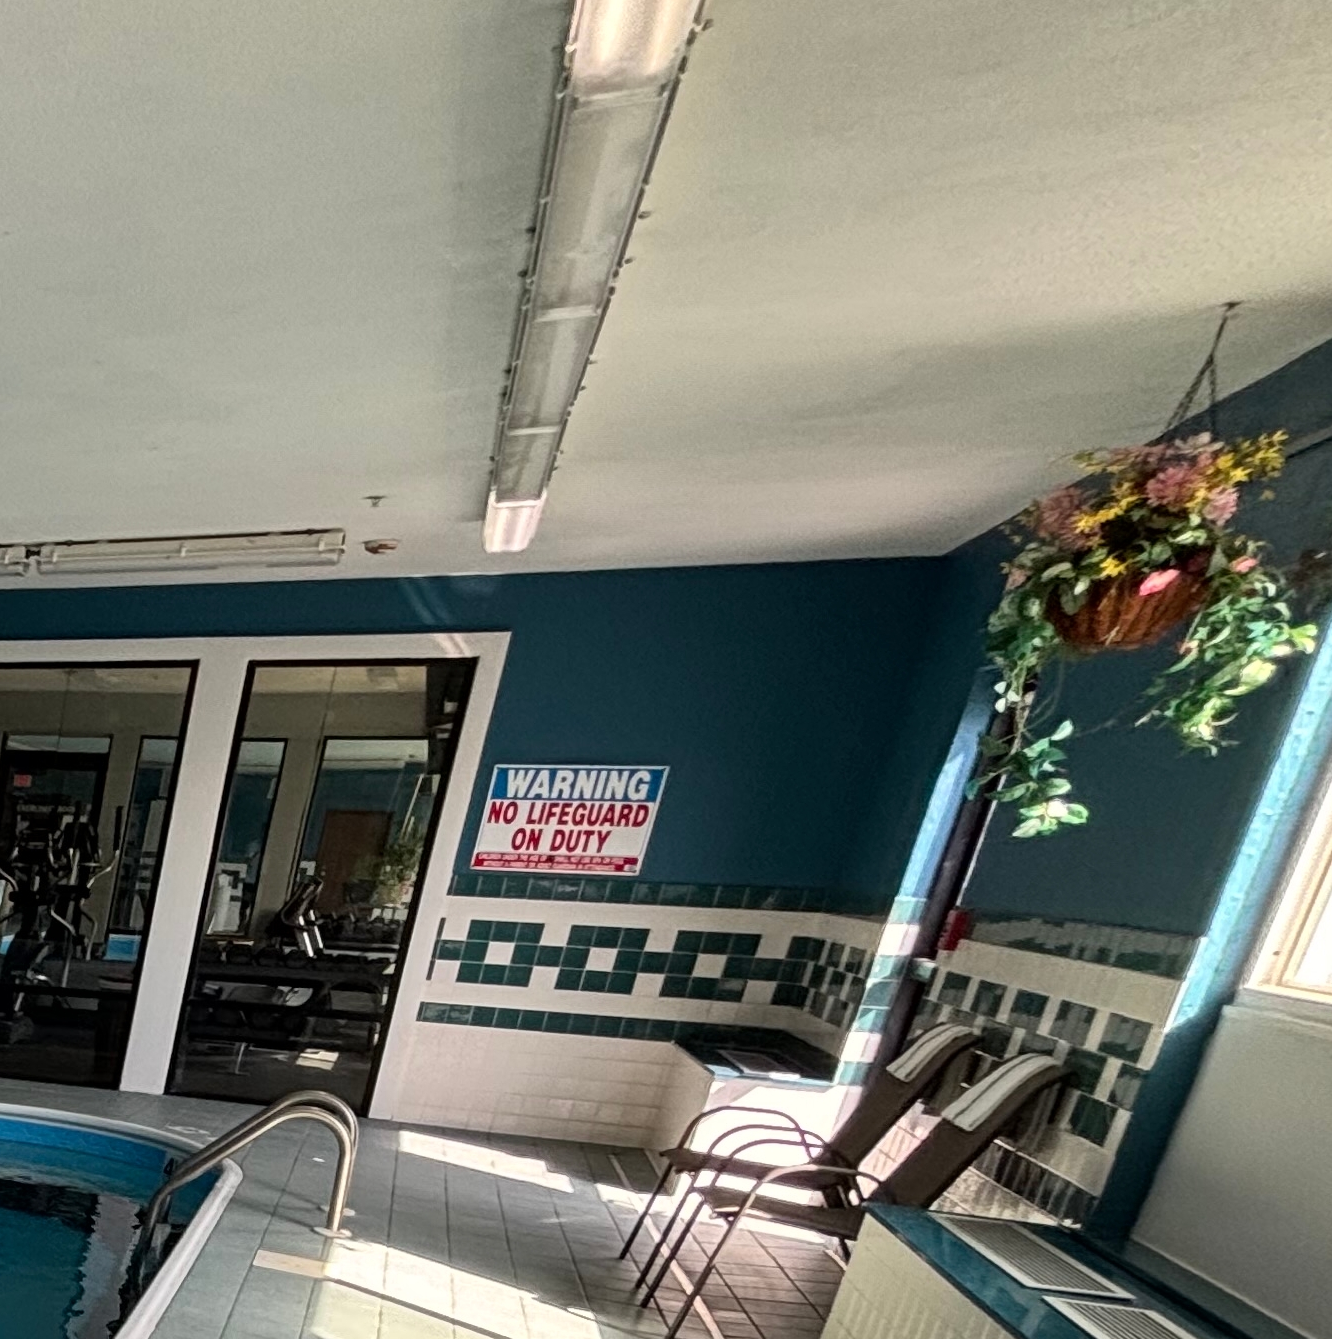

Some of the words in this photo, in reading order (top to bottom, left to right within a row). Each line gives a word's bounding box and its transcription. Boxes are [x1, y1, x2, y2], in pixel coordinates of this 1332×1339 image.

[505, 769, 652, 801] WARNING
[486, 801, 518, 825] NO
[525, 801, 650, 828] LIFEGUARD
[511, 828, 543, 852] ON
[549, 829, 613, 854] DUTY
